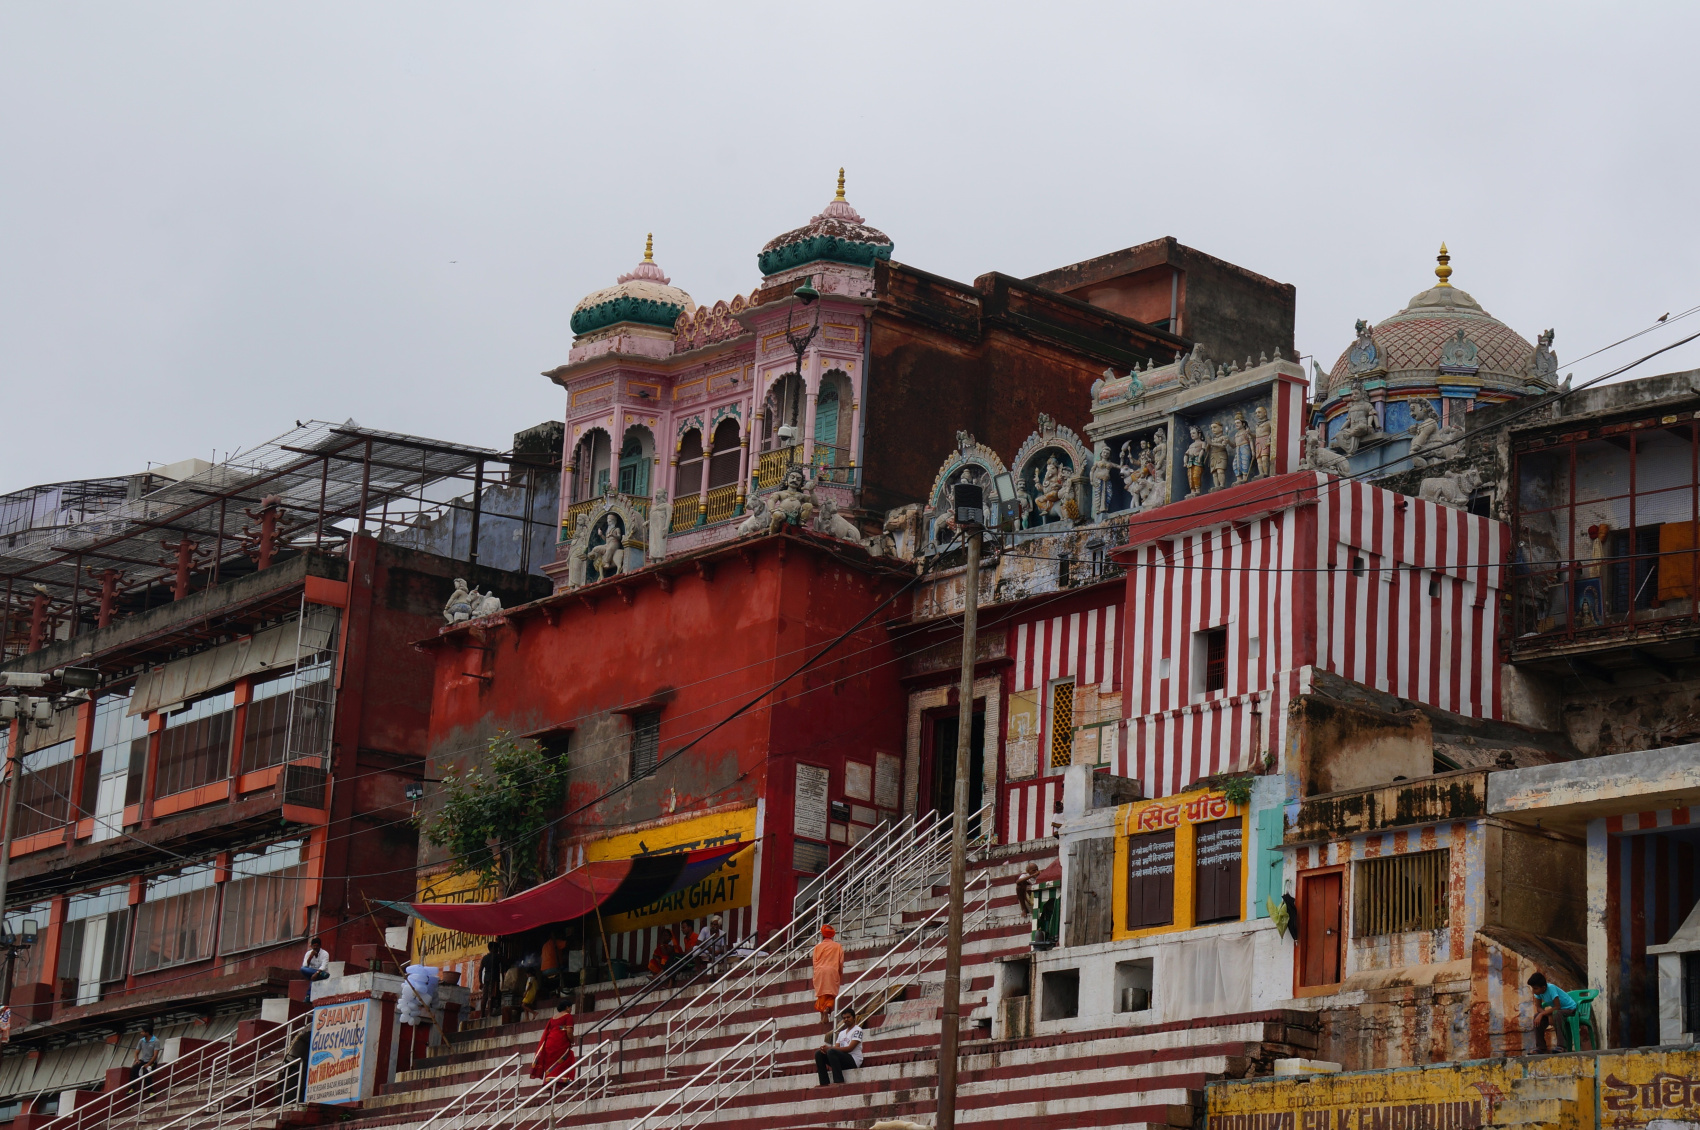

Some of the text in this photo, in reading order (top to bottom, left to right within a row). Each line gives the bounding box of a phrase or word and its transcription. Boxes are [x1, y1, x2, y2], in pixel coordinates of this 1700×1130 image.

[689, 874, 739, 908] GHAT
[417, 930, 497, 956] VJAYANAGARAM
[317, 1004, 365, 1030] SHANTI
[1603, 1072, 1700, 1111] राधि
